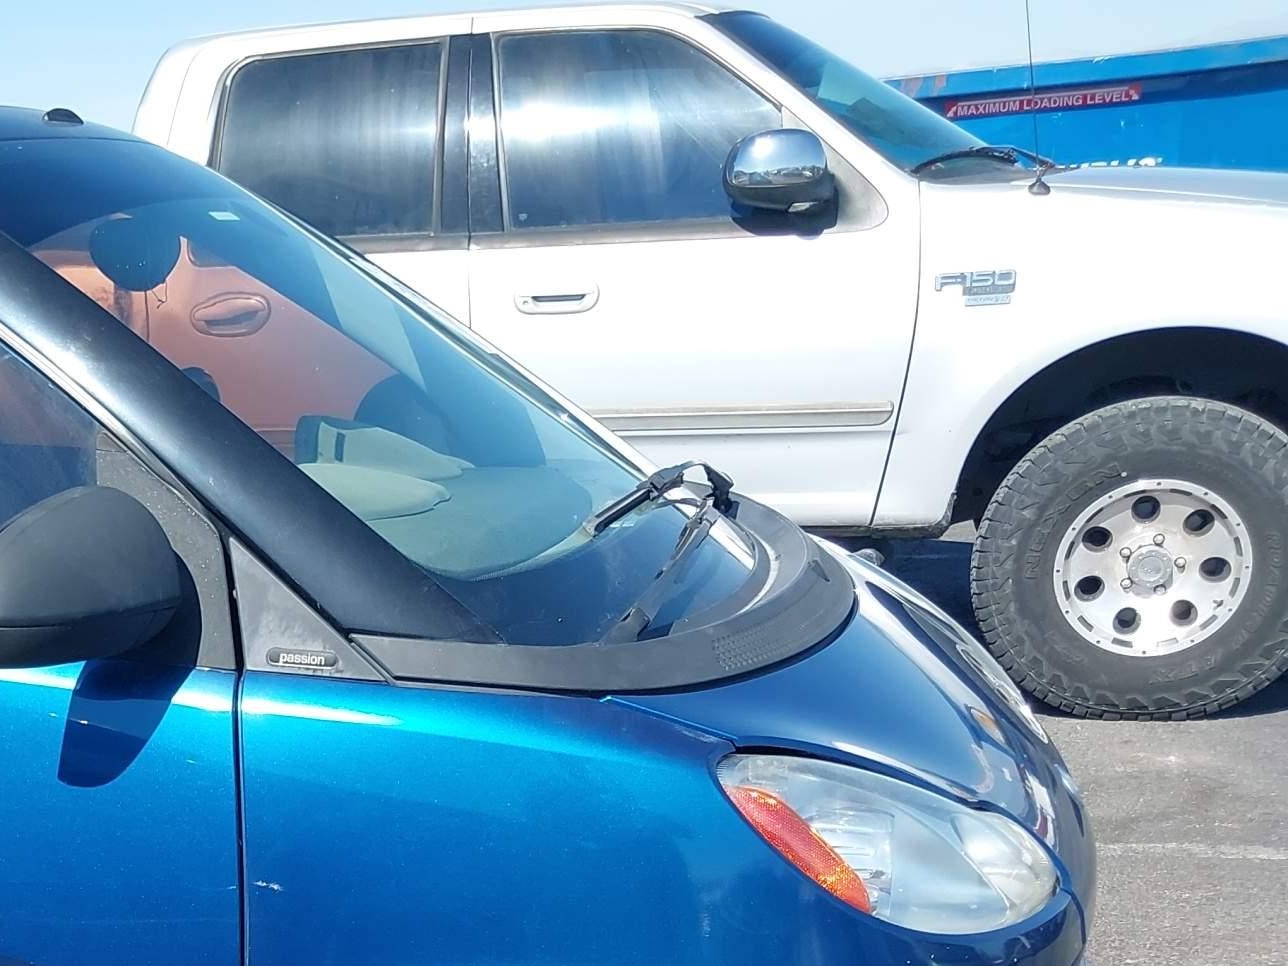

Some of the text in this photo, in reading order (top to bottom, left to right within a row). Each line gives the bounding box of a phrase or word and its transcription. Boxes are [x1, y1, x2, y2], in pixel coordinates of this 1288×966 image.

[958, 90, 1130, 117] MAXIMUM LOADING LEVEL
[279, 652, 325, 666] passion
